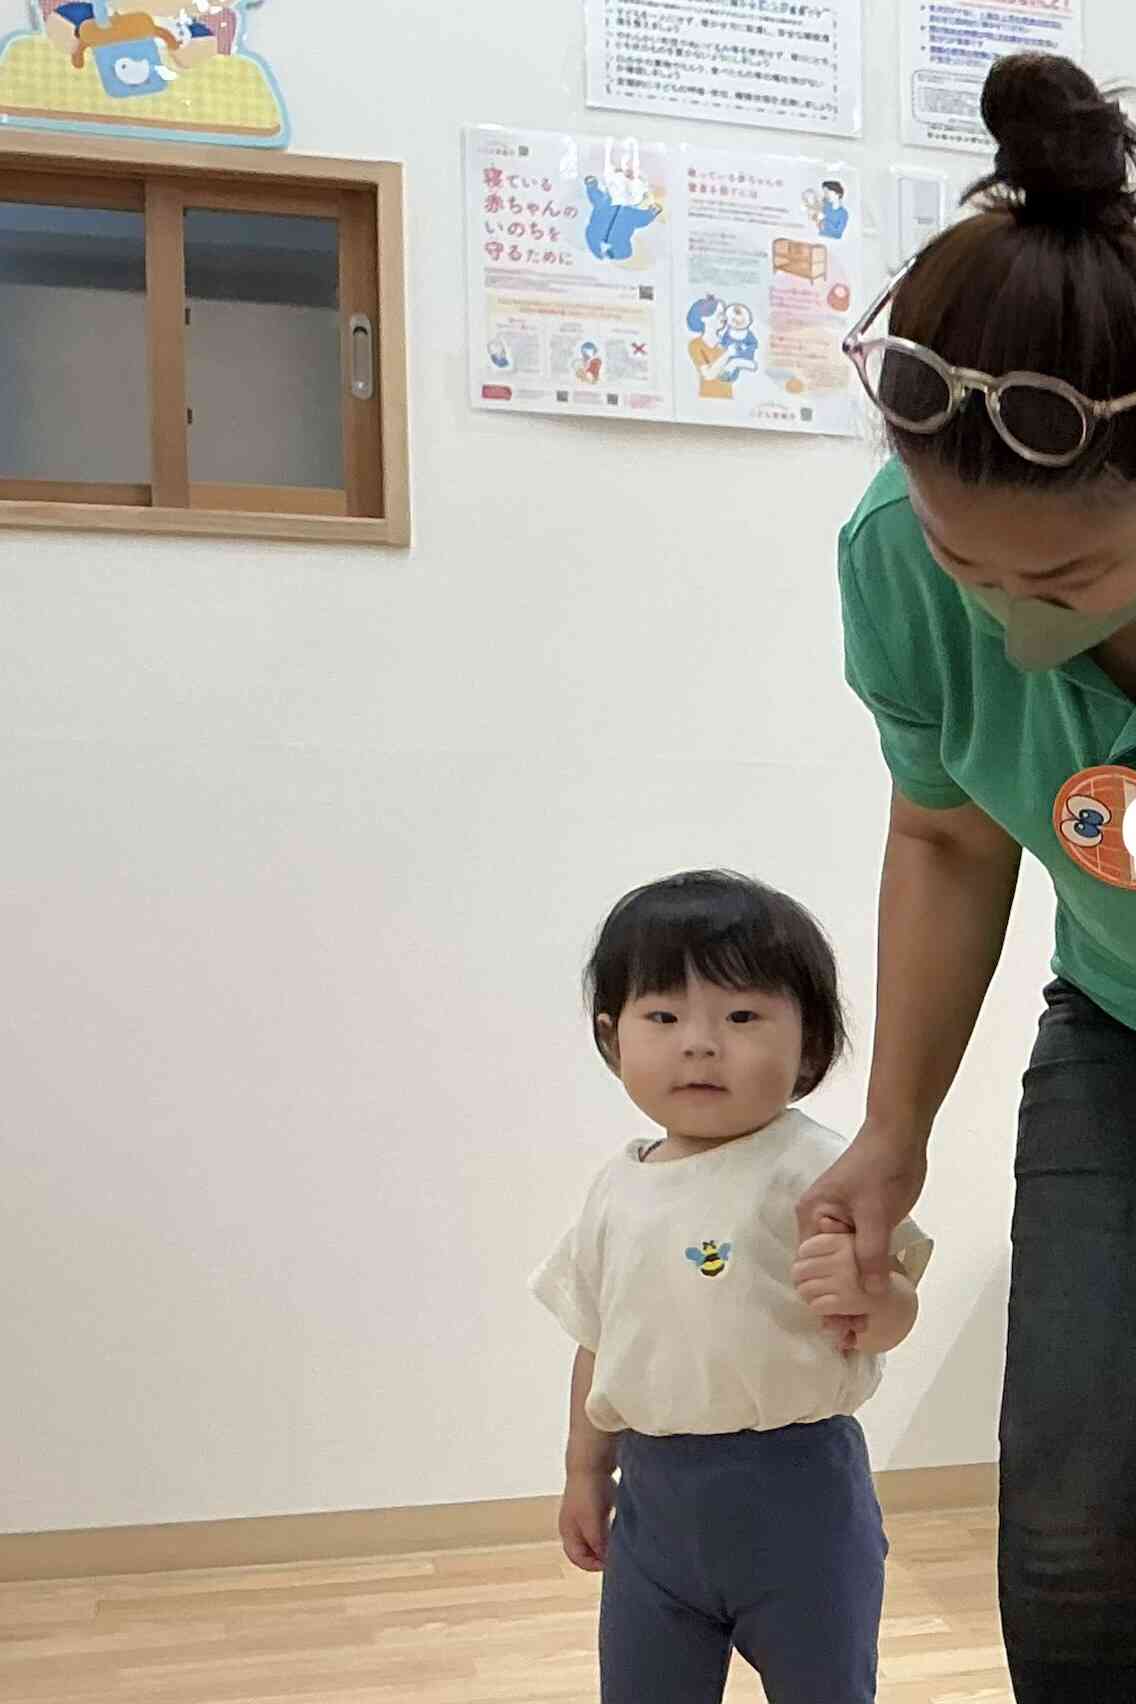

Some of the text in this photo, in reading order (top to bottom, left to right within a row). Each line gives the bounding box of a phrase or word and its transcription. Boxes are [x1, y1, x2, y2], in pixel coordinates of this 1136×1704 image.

[483, 163, 553, 192] 寝ている
[484, 191, 578, 219] 赤ちゃんの
[484, 219, 560, 242] いのちを
[484, 240, 574, 266] 守るために
